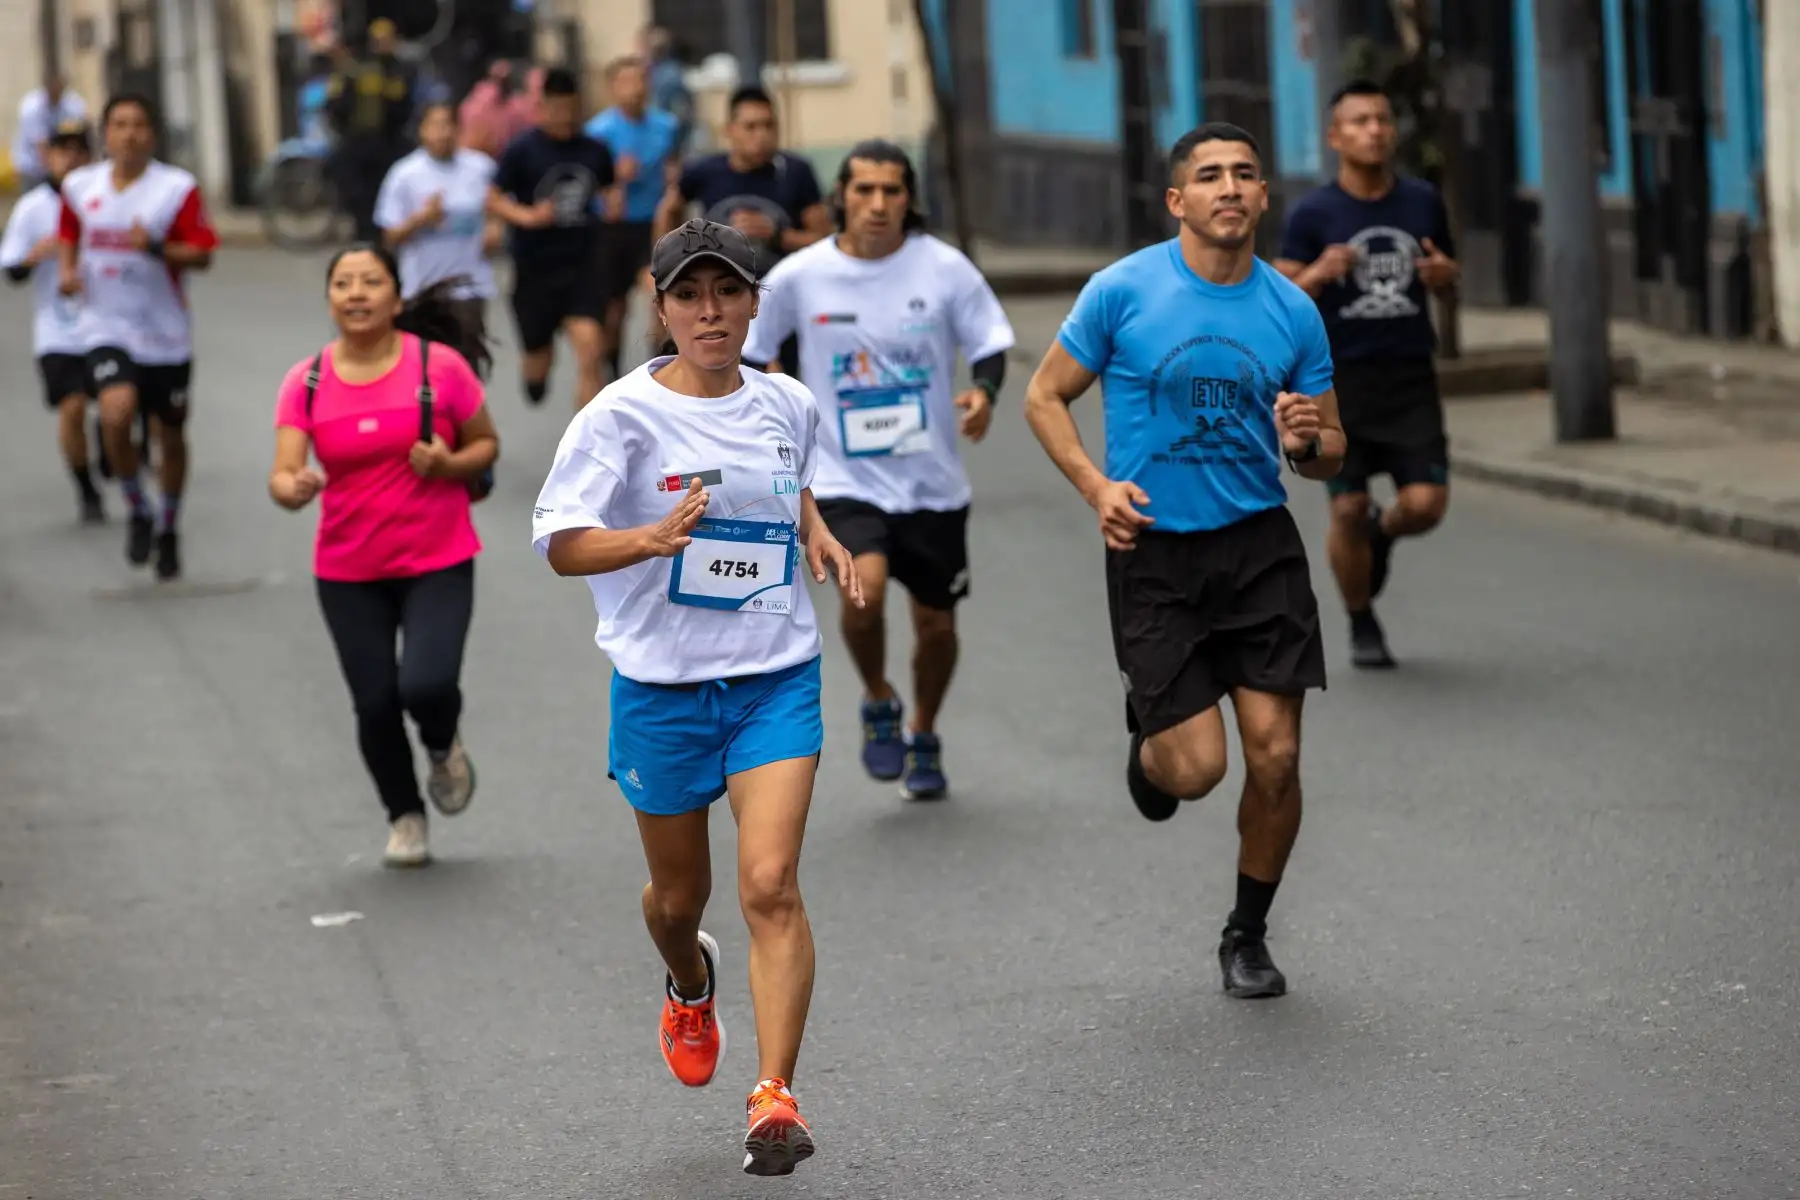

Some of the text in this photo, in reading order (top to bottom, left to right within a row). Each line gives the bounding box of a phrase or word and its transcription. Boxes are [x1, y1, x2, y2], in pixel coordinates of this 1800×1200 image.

[1192, 377, 1239, 410] ETE
[708, 559, 759, 579] 4754
[766, 602, 789, 611] LIMA
